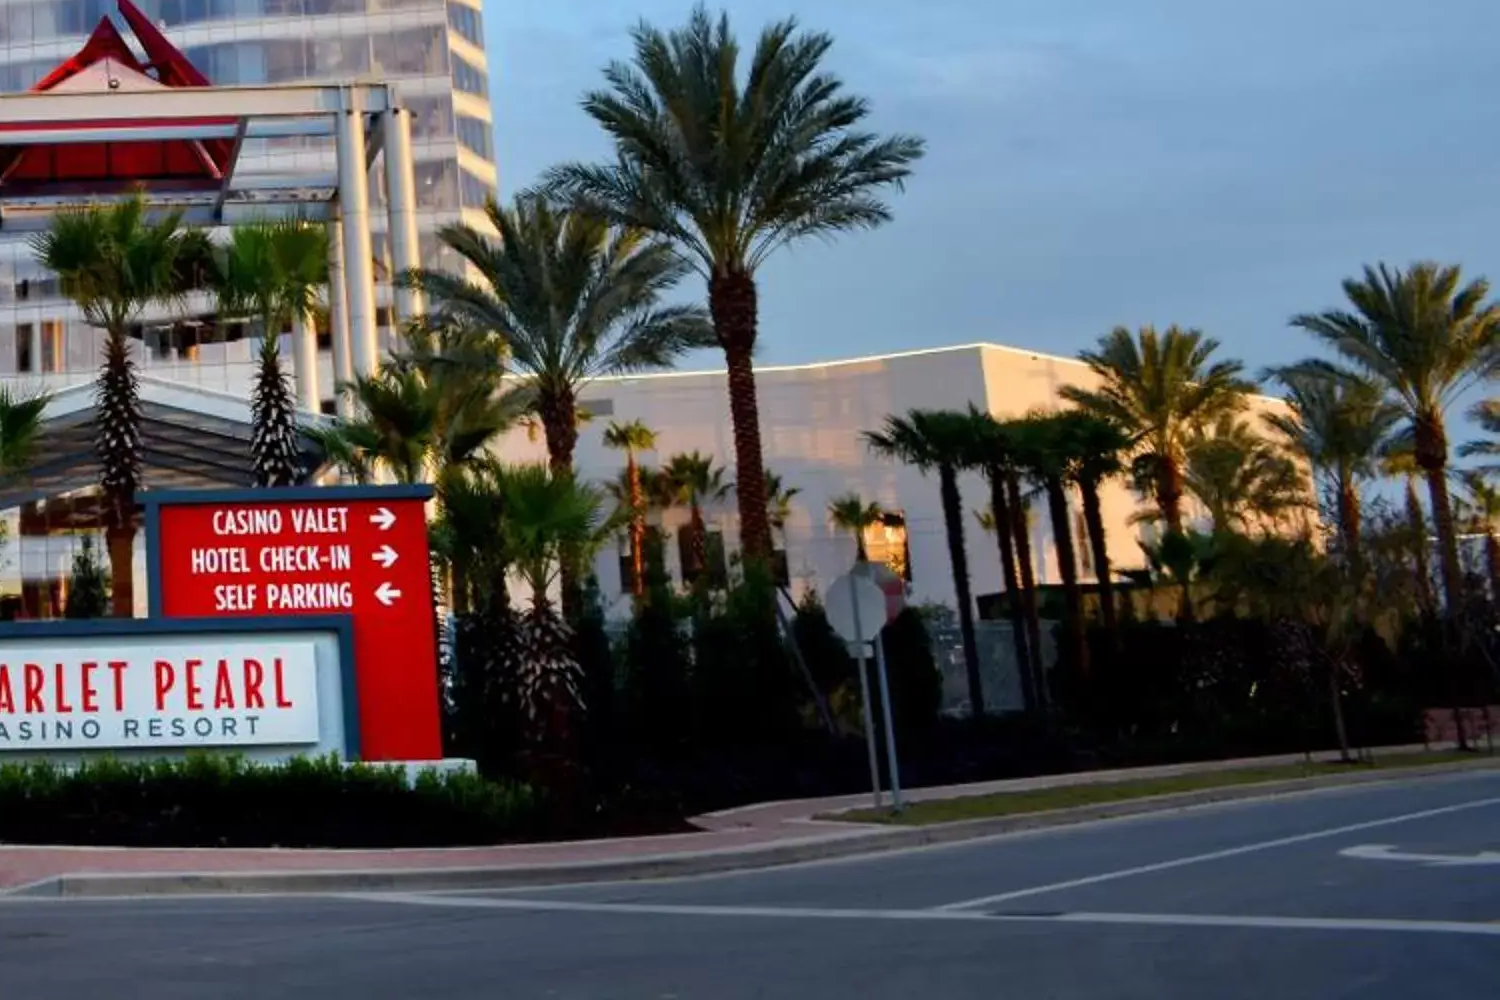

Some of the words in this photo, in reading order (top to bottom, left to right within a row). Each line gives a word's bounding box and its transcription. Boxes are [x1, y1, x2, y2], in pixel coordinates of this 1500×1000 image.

[213, 508, 282, 535] CASINO
[291, 507, 348, 533] VALET
[191, 547, 250, 574] HOTEL
[260, 545, 351, 572] CHECK-IN
[214, 583, 257, 610] SELF
[267, 581, 353, 608] PARKING
[154, 658, 293, 711] PEARL
[124, 715, 260, 739] RESORT
